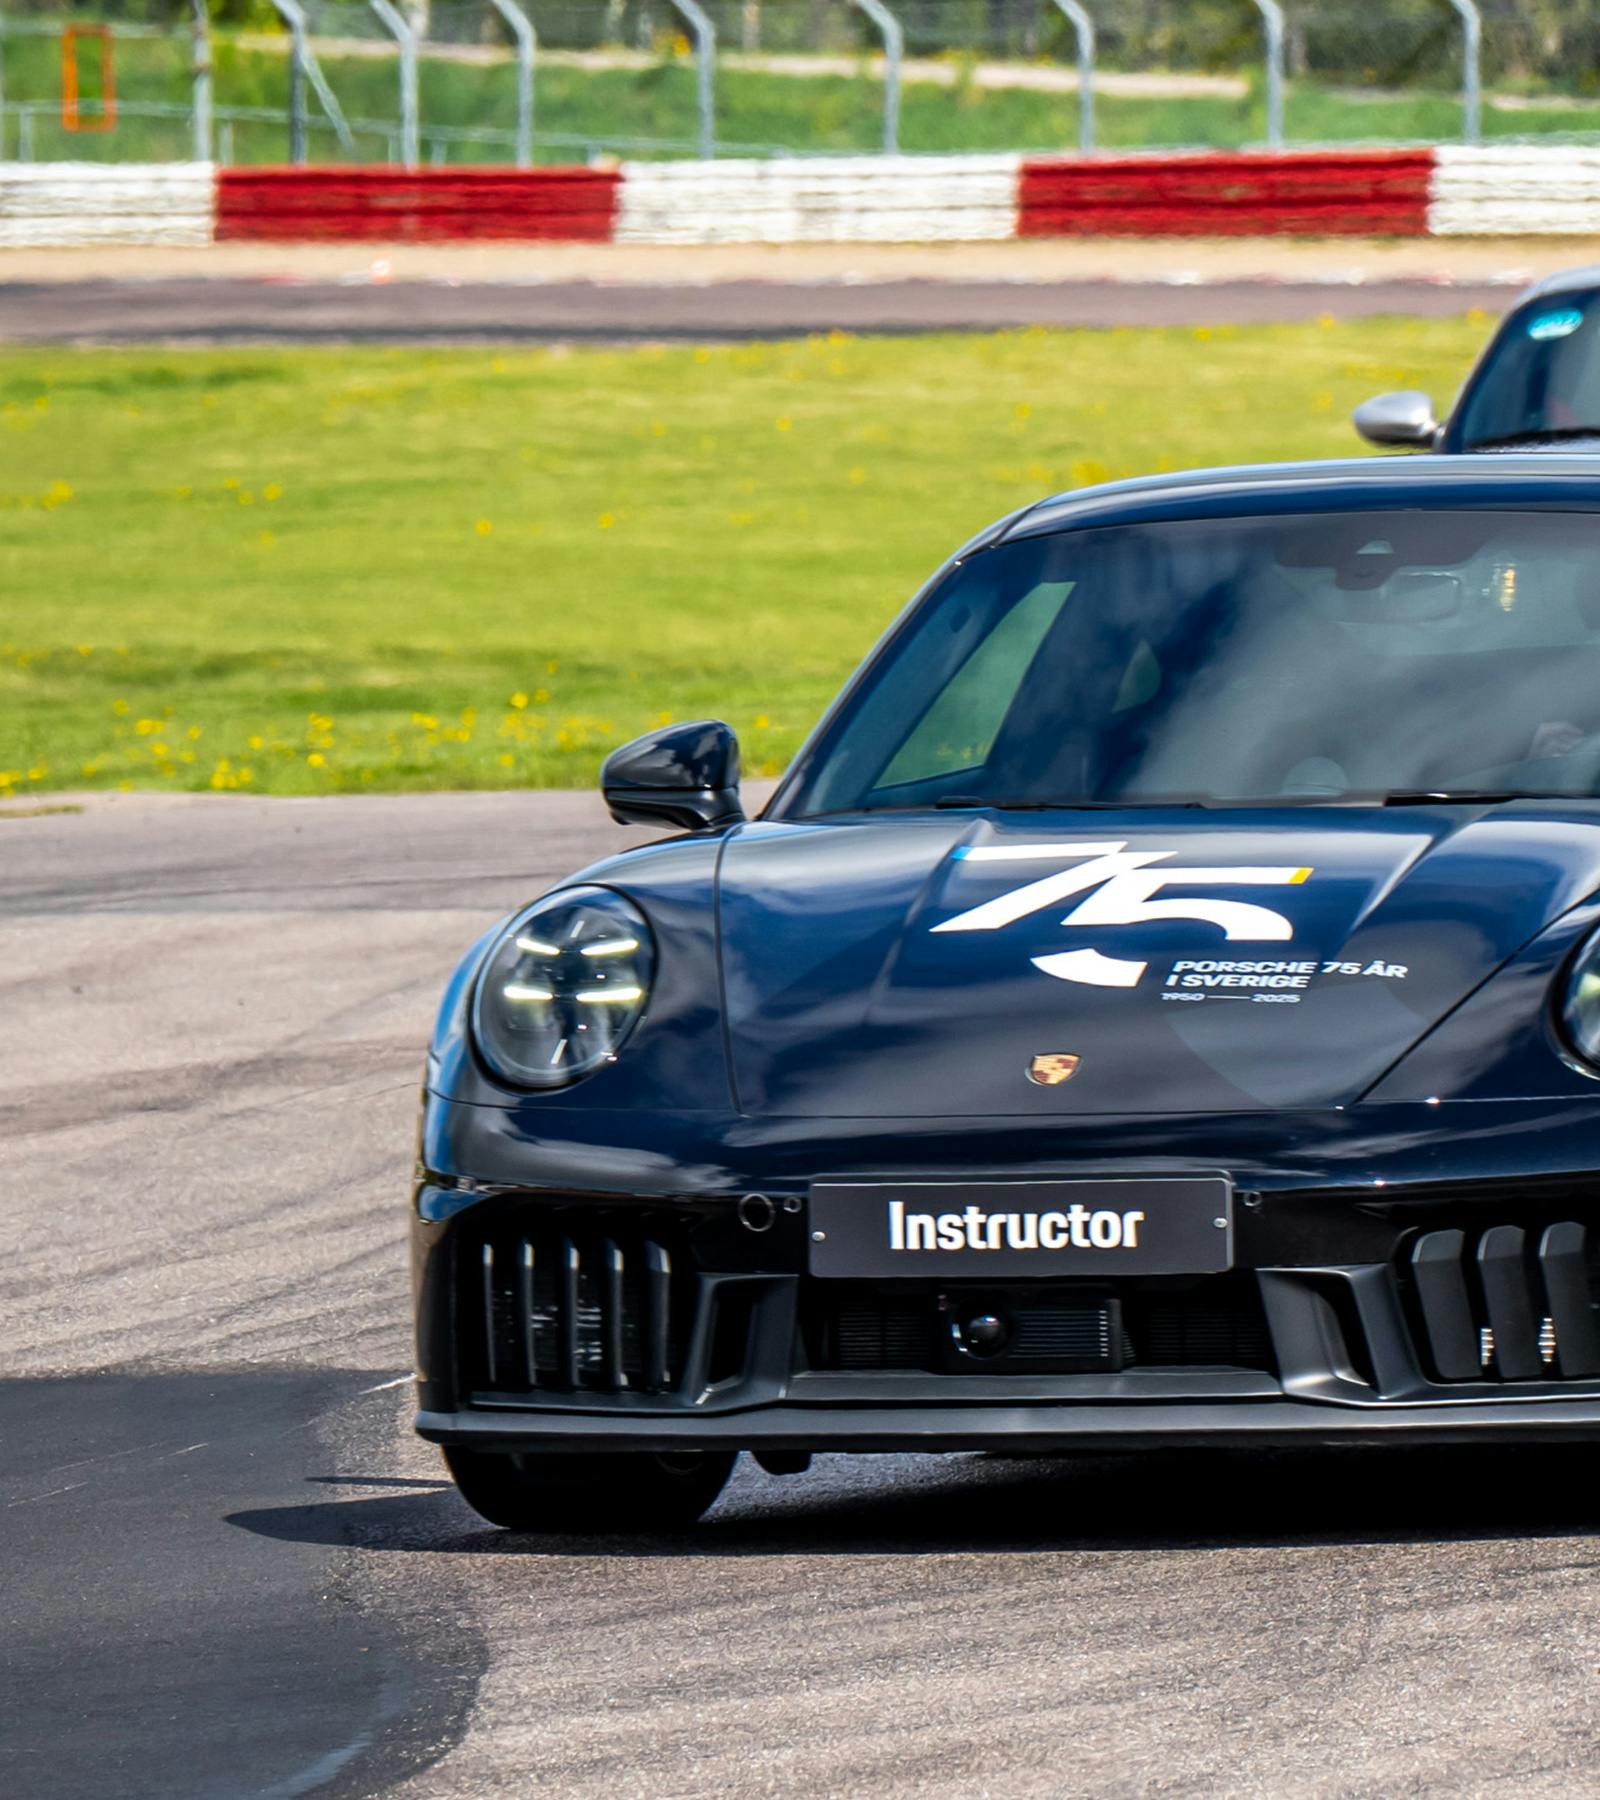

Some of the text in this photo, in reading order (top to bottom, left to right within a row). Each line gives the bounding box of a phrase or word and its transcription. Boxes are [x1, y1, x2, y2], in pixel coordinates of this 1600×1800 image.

[929, 841, 1314, 987] 75
[1165, 974, 1312, 989] I SVERIGE
[1172, 960, 1408, 979] PORSCHE 75 ÅR
[889, 1200, 1145, 1251] Instructor
